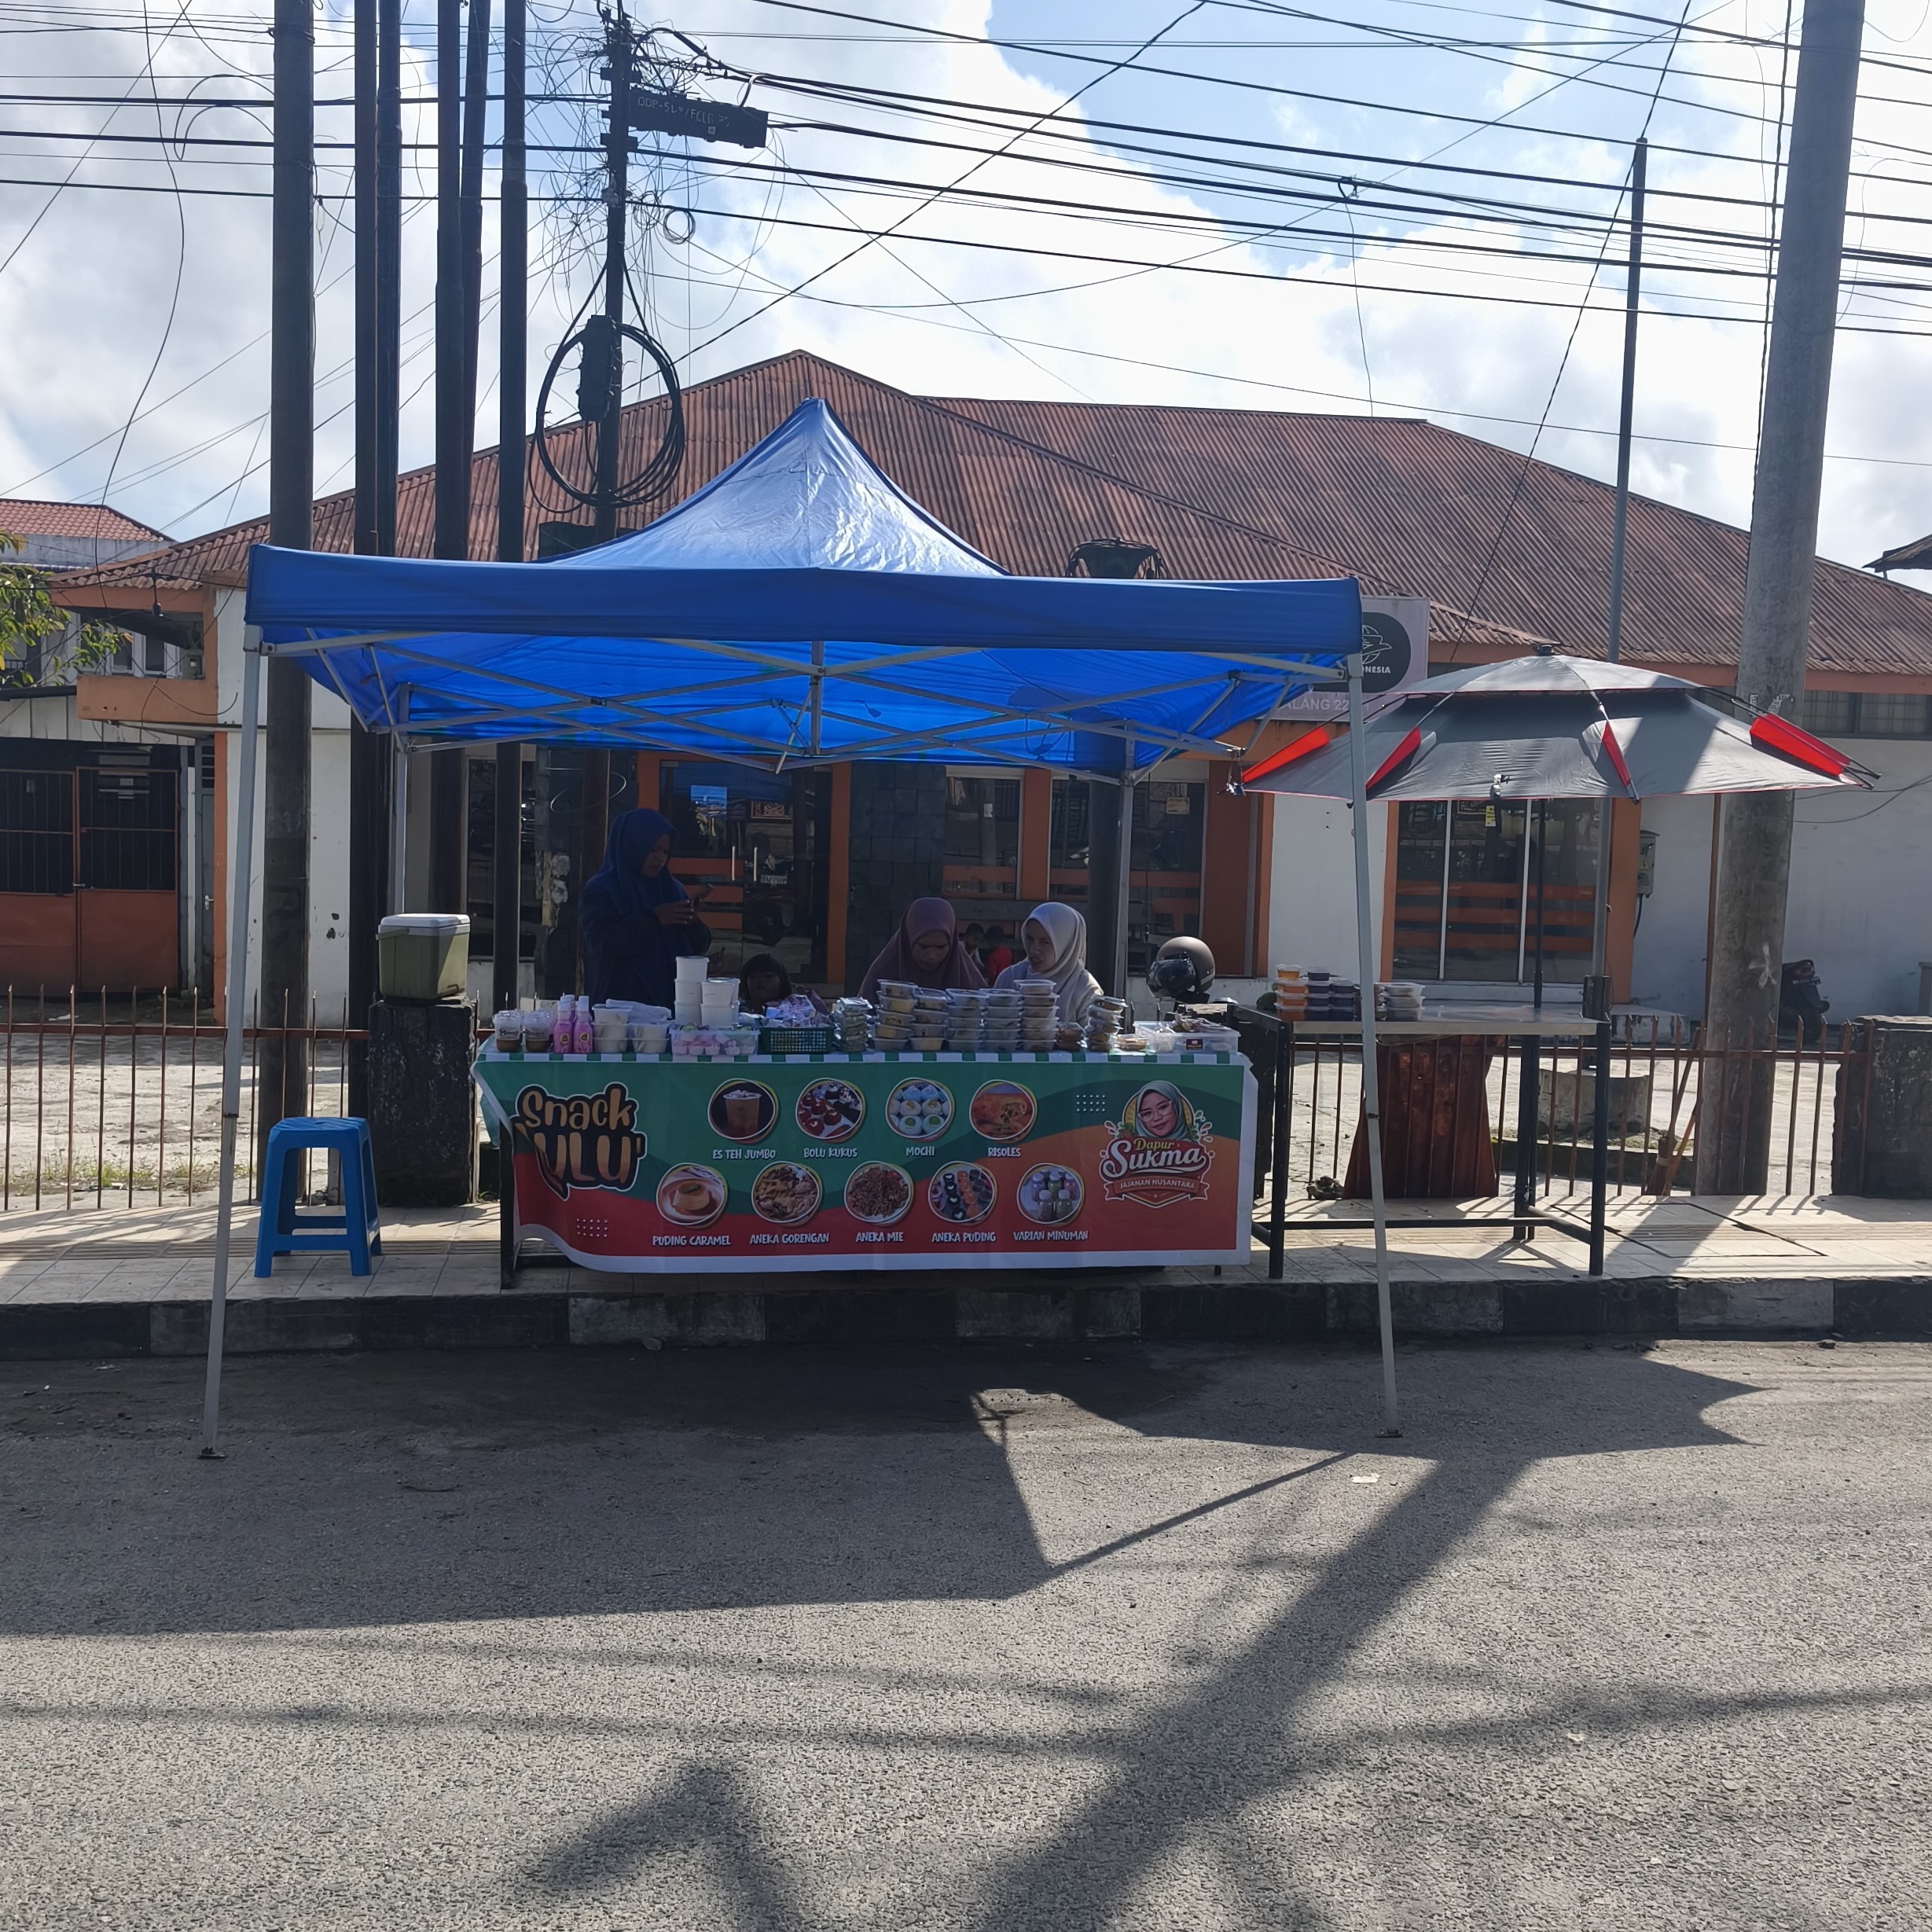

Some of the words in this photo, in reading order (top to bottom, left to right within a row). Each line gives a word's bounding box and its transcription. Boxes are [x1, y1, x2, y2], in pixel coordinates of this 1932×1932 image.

[521, 1088, 633, 1130] Snack
[1133, 1138, 1175, 1151] Dapur
[712, 1149, 723, 1159] ES
[725, 1149, 742, 1159] TEH
[744, 1148, 776, 1159] JUMBO
[803, 1148, 826, 1158] BOLU
[828, 1148, 858, 1158] KUKUS
[905, 1146, 935, 1156] MOCHI
[988, 1147, 1021, 1157] RISOLES
[1103, 1140, 1207, 1177] Sukma
[1120, 1180, 1150, 1188] JAJANAN
[1151, 1179, 1195, 1188] NUSANTARA
[652, 1235, 687, 1246] PUDING
[689, 1235, 731, 1246] CARAMEL
[750, 1234, 780, 1244] ANEKA
[782, 1232, 829, 1244] GORENGAN
[856, 1231, 885, 1243] ANEKA
[887, 1231, 904, 1242] MIE
[931, 1232, 961, 1243] ANEKA
[963, 1232, 996, 1243] PUDING
[1013, 1230, 1045, 1241] VARIAN
[1047, 1229, 1088, 1241] MINUMAN
